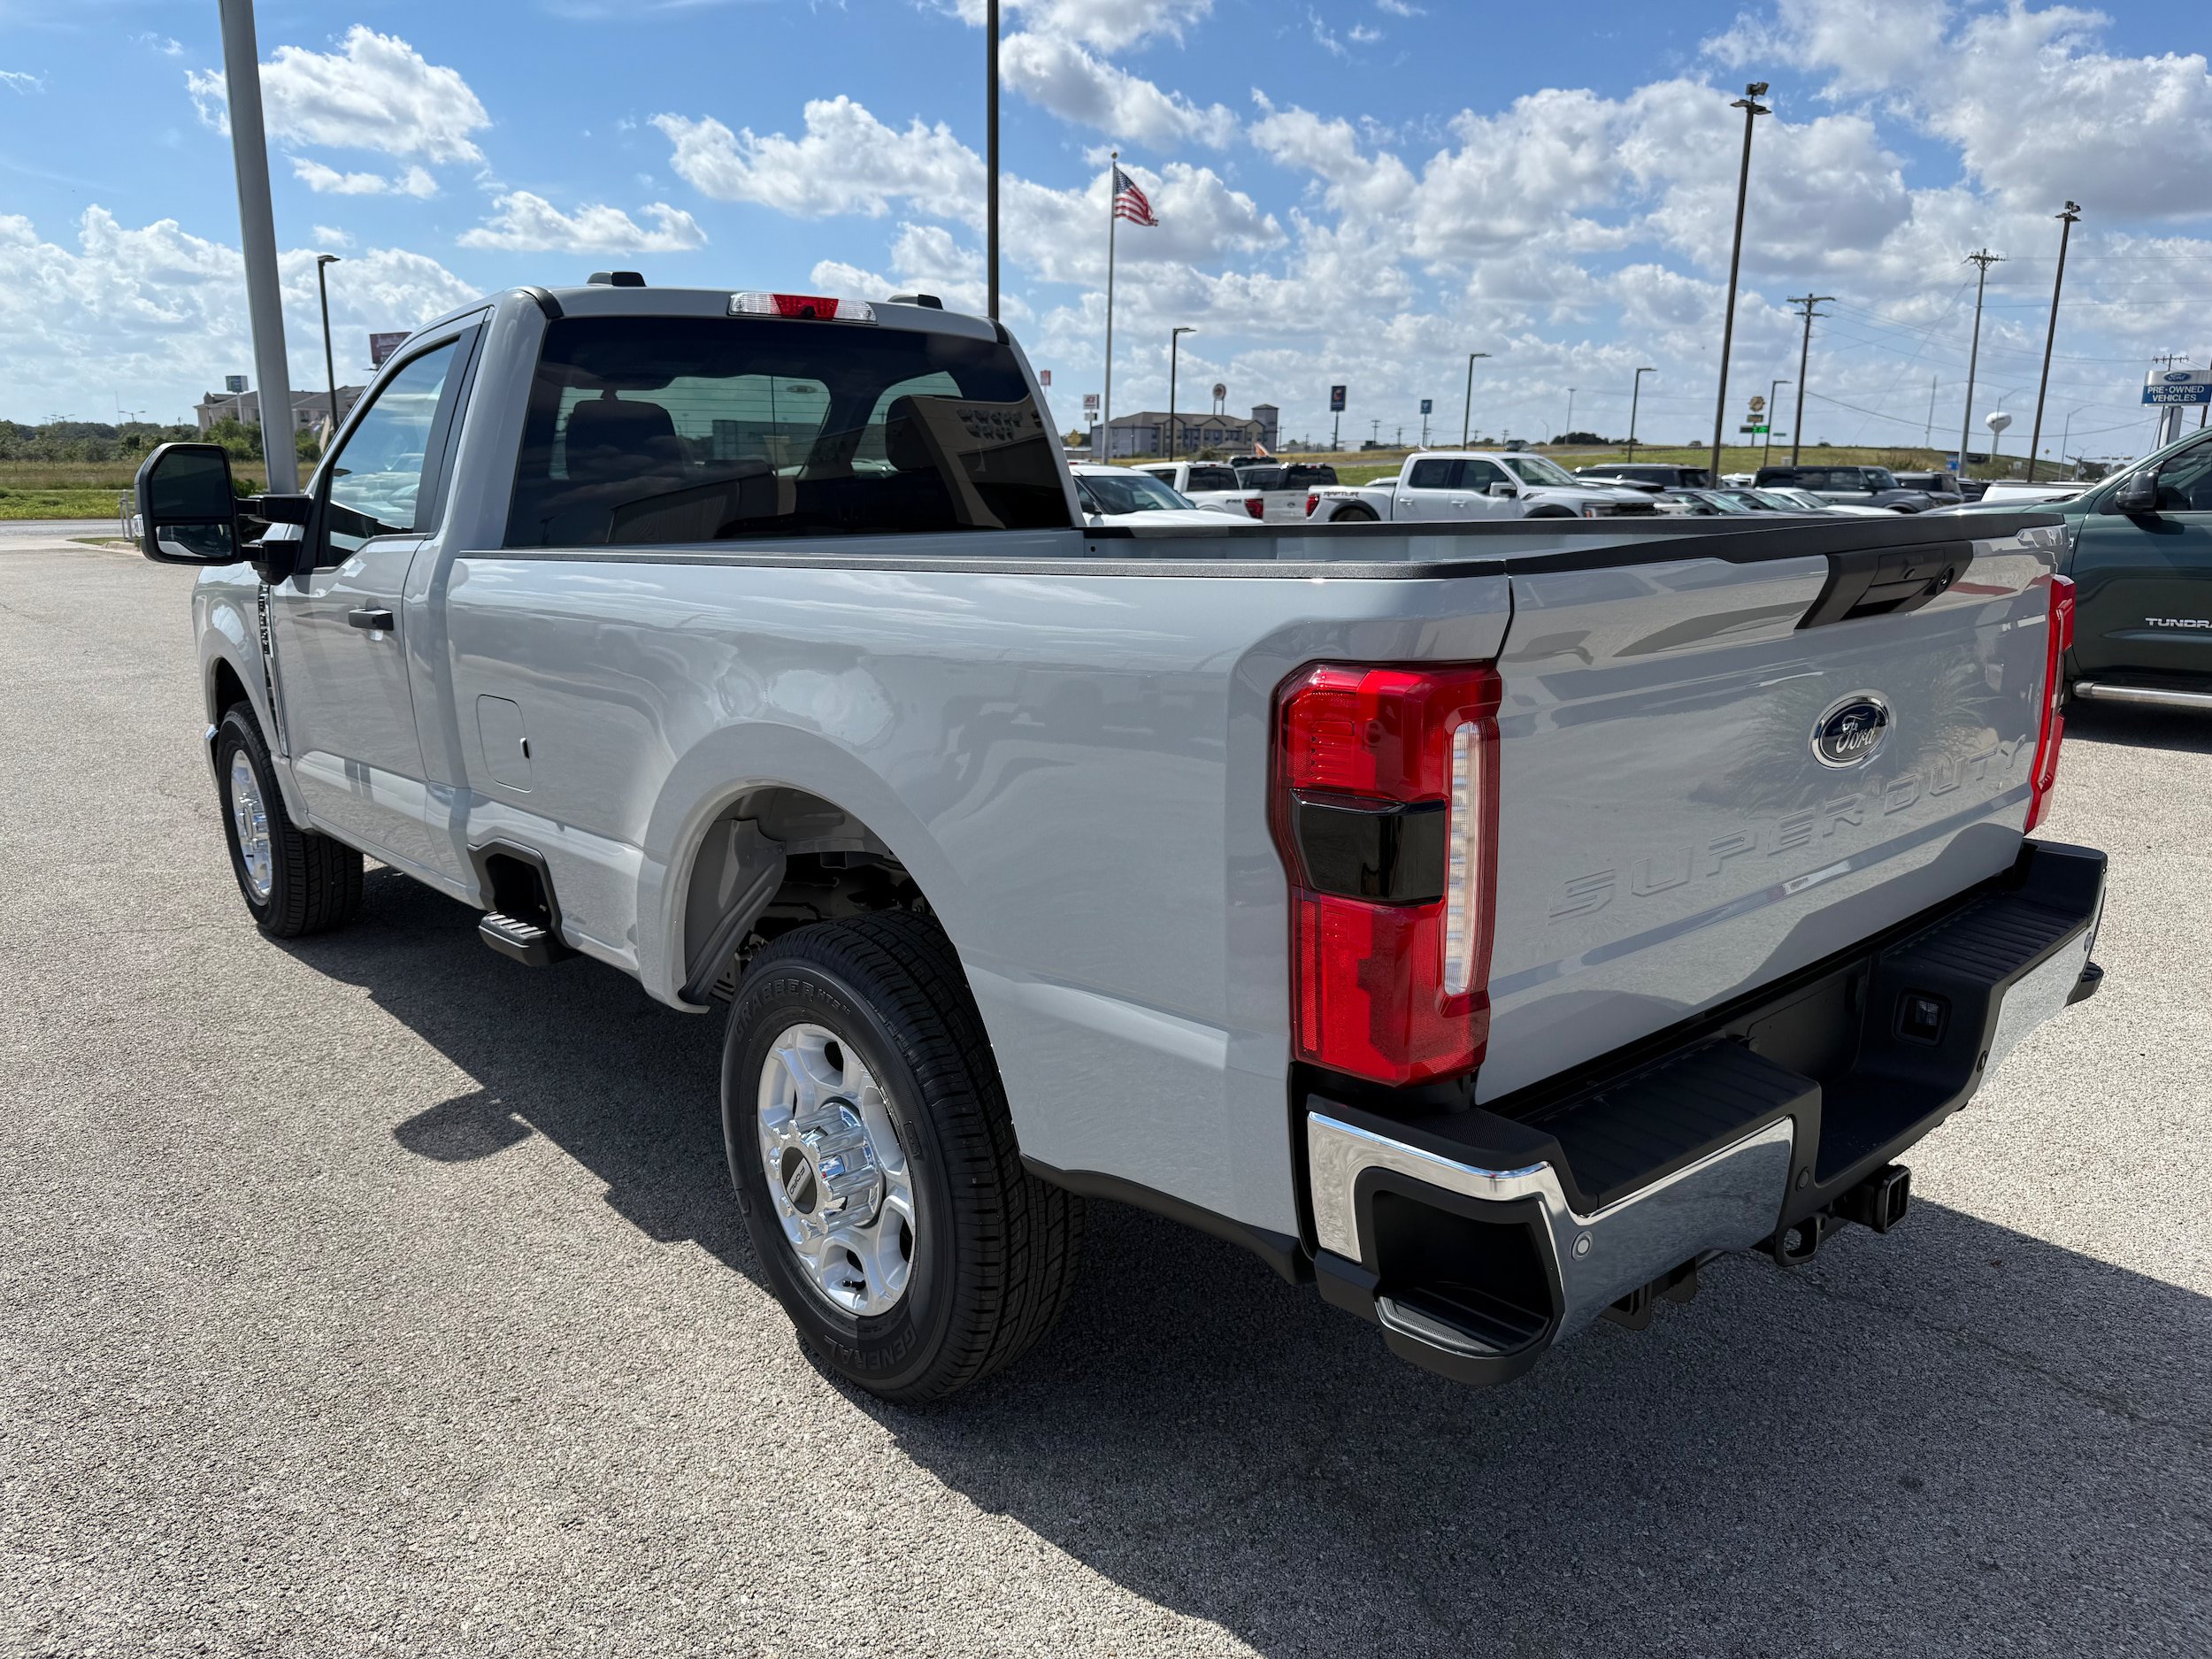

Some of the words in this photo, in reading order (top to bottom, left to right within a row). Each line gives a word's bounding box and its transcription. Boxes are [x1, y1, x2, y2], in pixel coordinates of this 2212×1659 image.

[1548, 793, 1863, 925] SUPER
[1884, 733, 2026, 816] DUTY
[735, 978, 815, 1039] GRABBER
[789, 1165, 805, 1194] FORD
[824, 1323, 918, 1371] GENERAL
